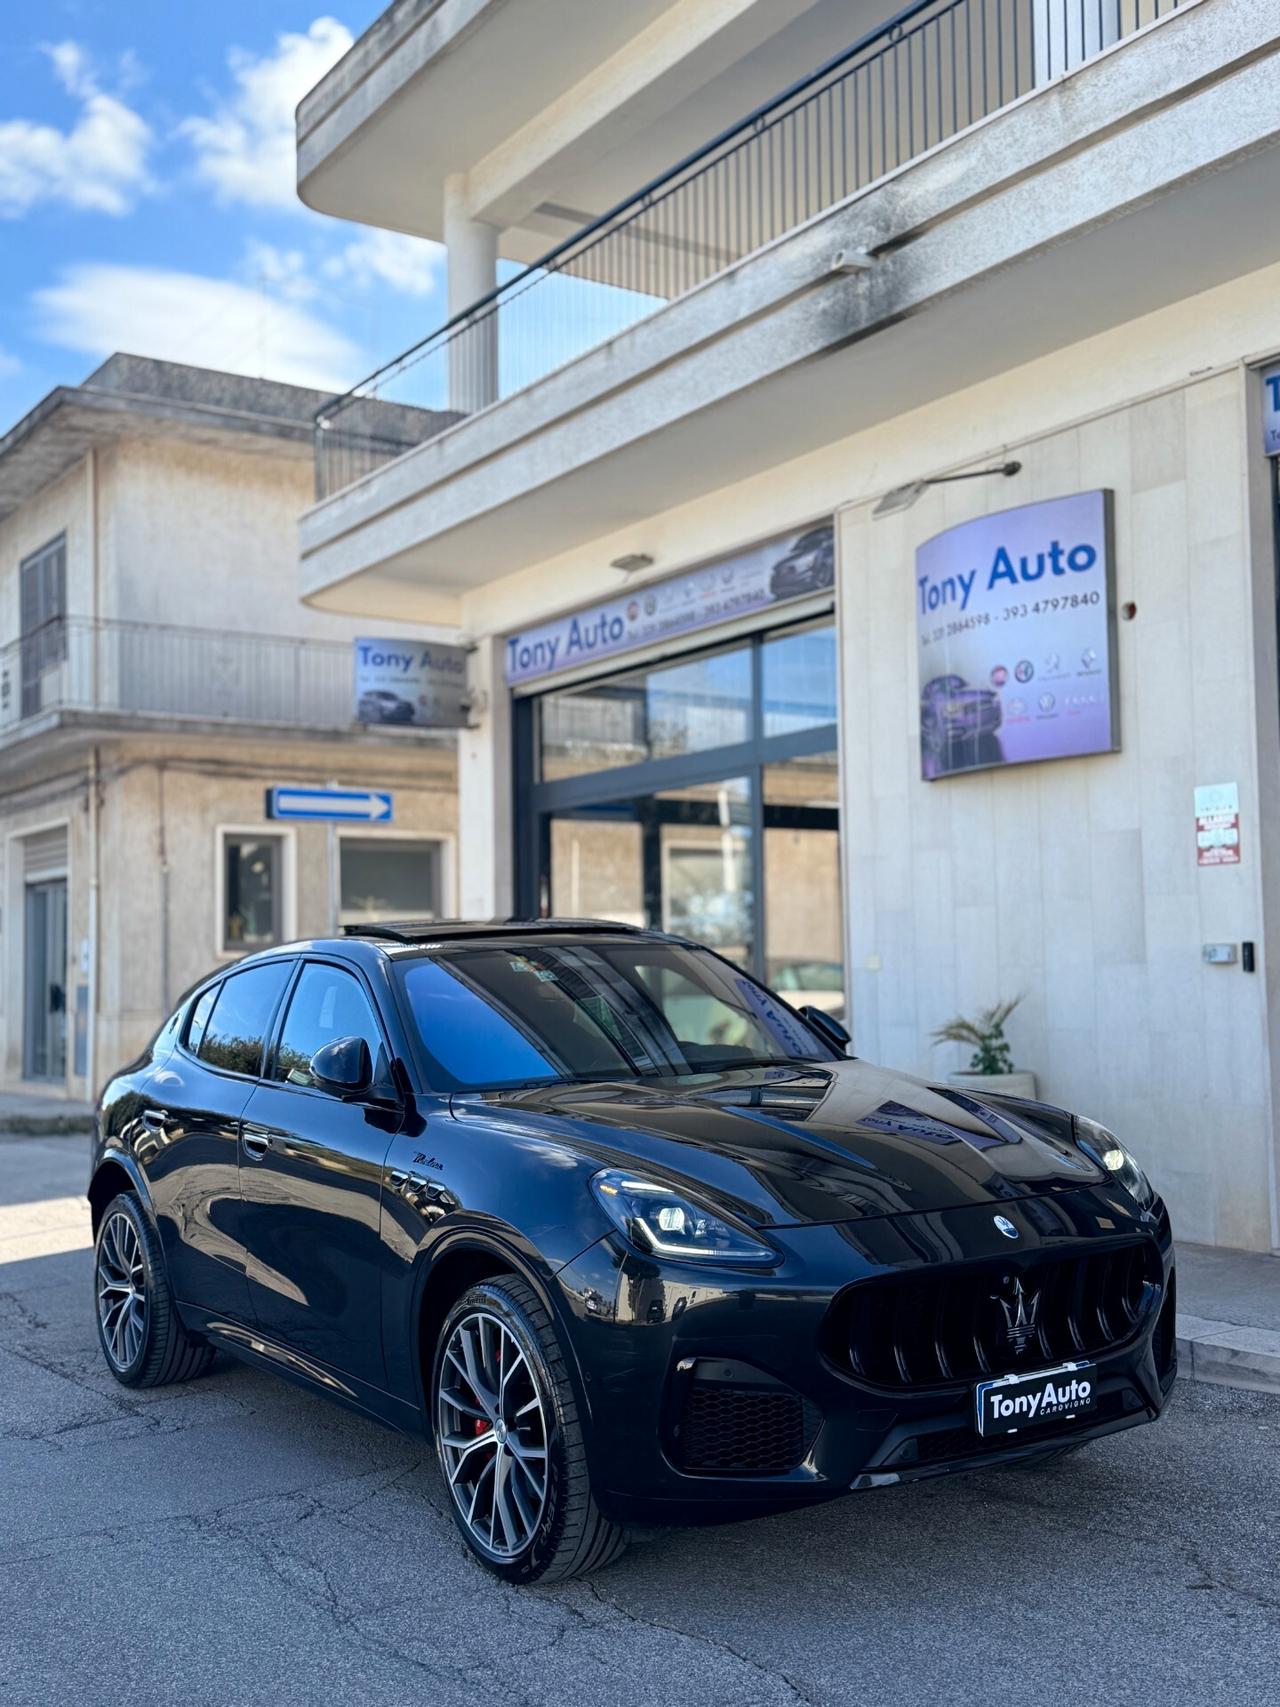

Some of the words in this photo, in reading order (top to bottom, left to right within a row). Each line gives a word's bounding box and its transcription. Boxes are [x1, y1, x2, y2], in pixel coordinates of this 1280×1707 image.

[918, 569, 977, 615] Tony
[987, 540, 1097, 590] Auto
[1003, 604, 1028, 621] 393
[1032, 591, 1101, 614] 4797840
[358, 646, 414, 673] Tony
[420, 650, 464, 673] Auto
[508, 637, 560, 672] Tony
[568, 614, 624, 654] Auto
[990, 1379, 1091, 1418] TonyAuto
[1040, 1397, 1091, 1415] CAROVIGNO
